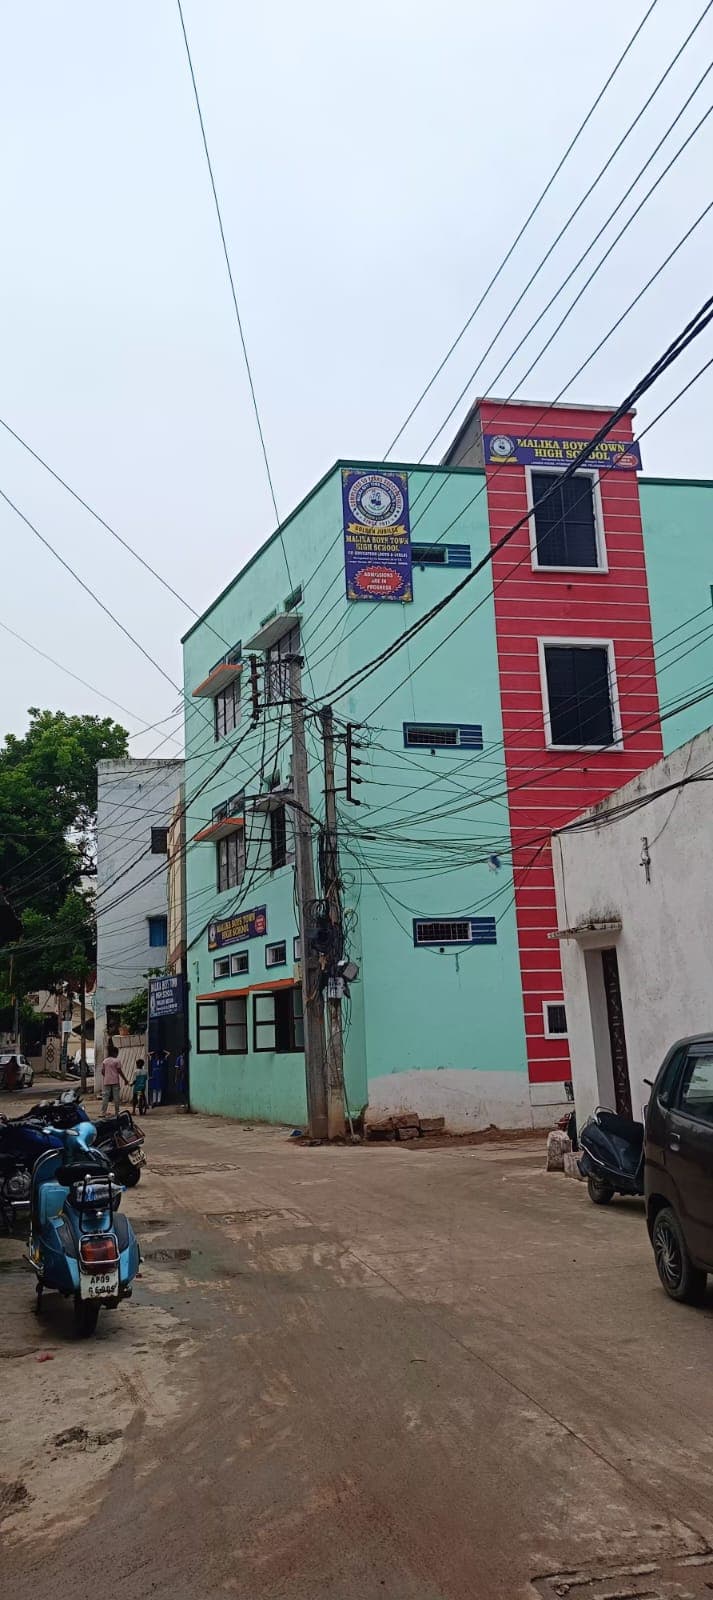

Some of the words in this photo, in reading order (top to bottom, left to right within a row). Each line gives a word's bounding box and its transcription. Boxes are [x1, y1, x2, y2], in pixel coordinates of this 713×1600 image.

[517, 439, 560, 449] MALIKA
[534, 449, 563, 458] HIGH
[390, 537, 409, 545] TOWN
[373, 543, 400, 551] SCHOOL
[90, 1275, 110, 1284] AP09
